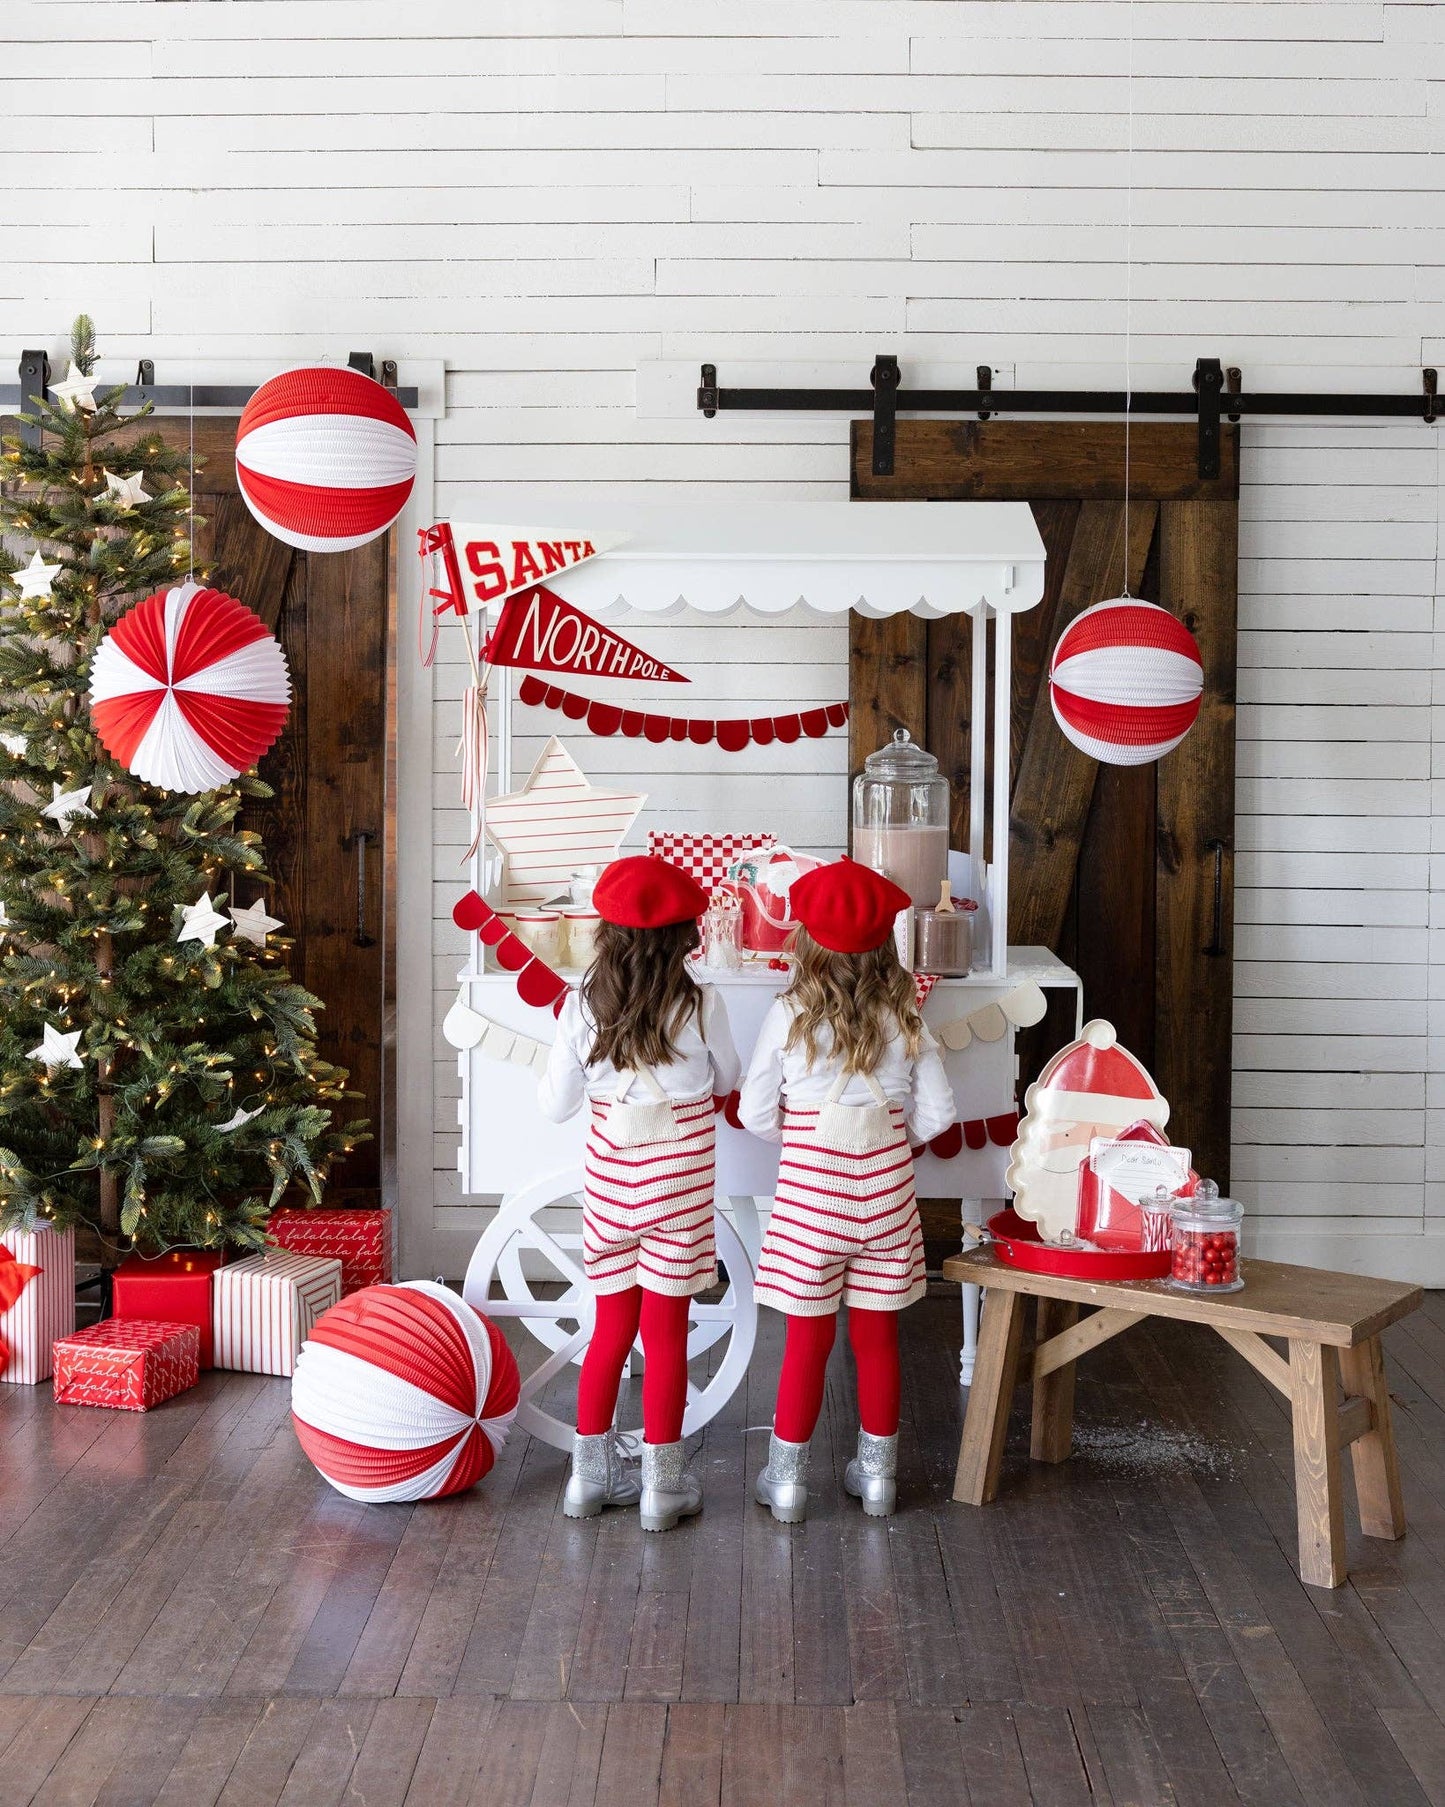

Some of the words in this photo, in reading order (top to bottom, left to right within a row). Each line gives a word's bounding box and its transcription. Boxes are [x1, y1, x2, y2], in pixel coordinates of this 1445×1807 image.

[465, 540, 596, 602] SANTA
[512, 592, 630, 675] NORTH
[629, 653, 670, 681] POLE
